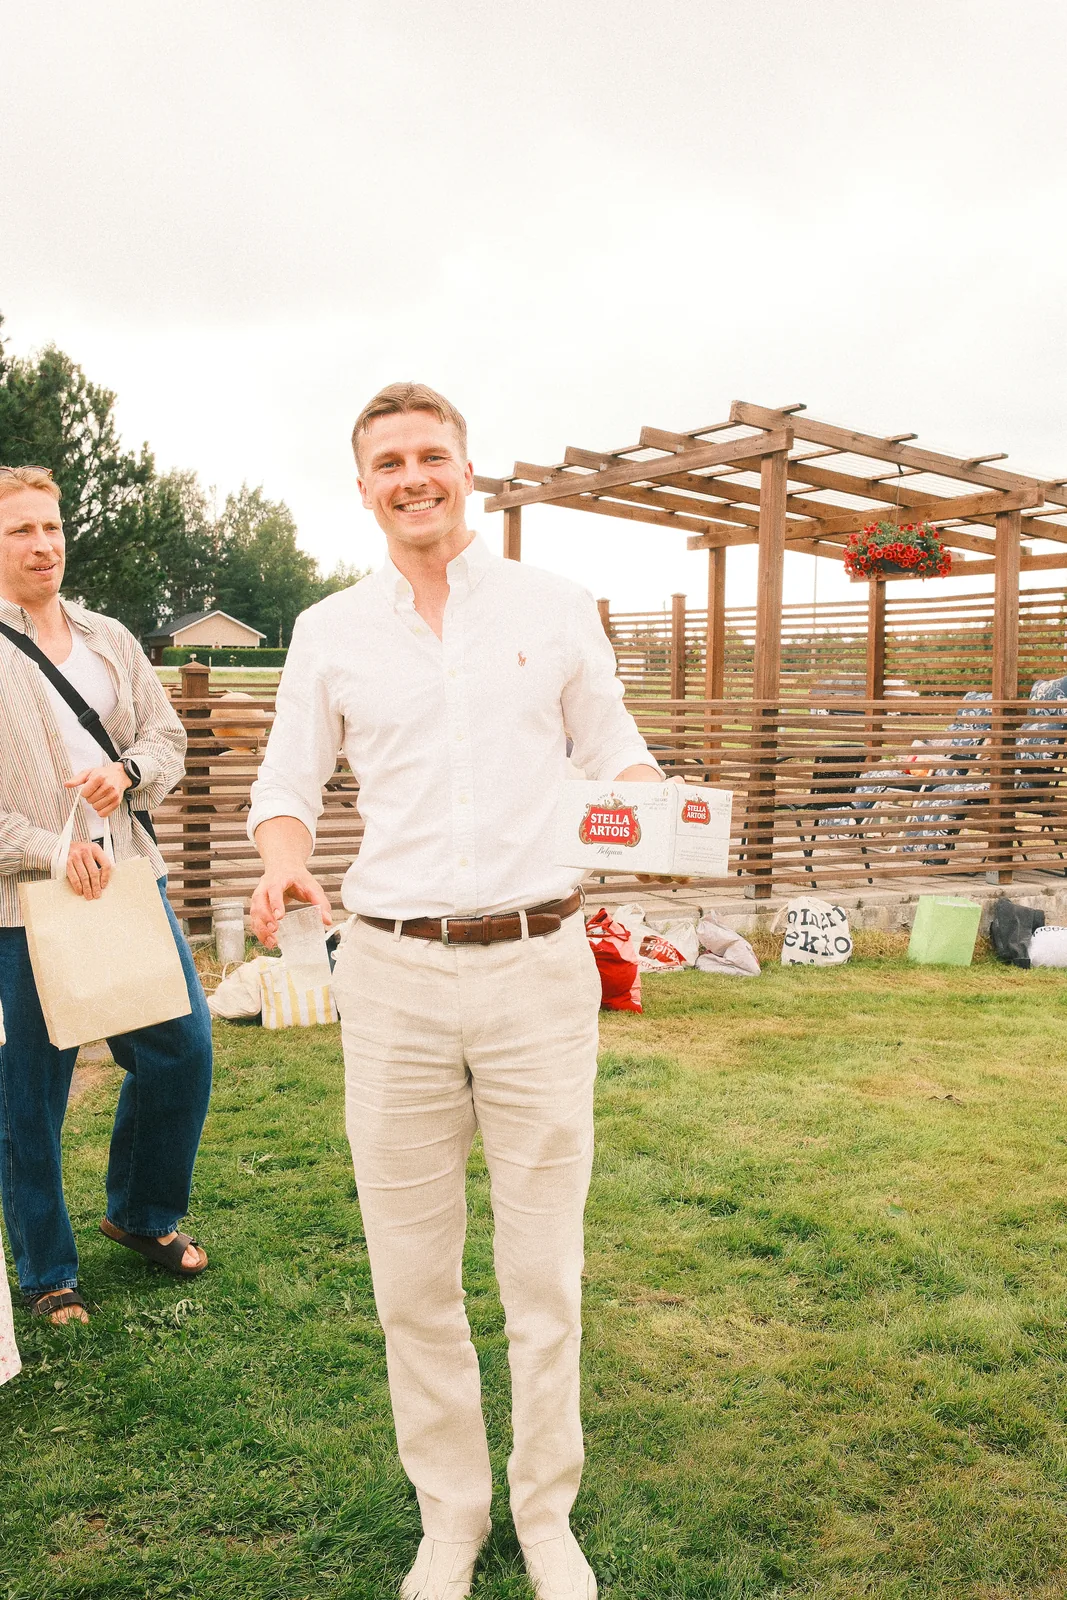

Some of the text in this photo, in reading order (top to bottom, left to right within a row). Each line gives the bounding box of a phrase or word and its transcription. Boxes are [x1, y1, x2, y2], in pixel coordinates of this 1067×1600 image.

[687, 804, 707, 813] STELLA
[590, 813, 630, 825] STELLA
[686, 811, 707, 820] ARTOIS
[589, 825, 630, 837] ARTOIS
